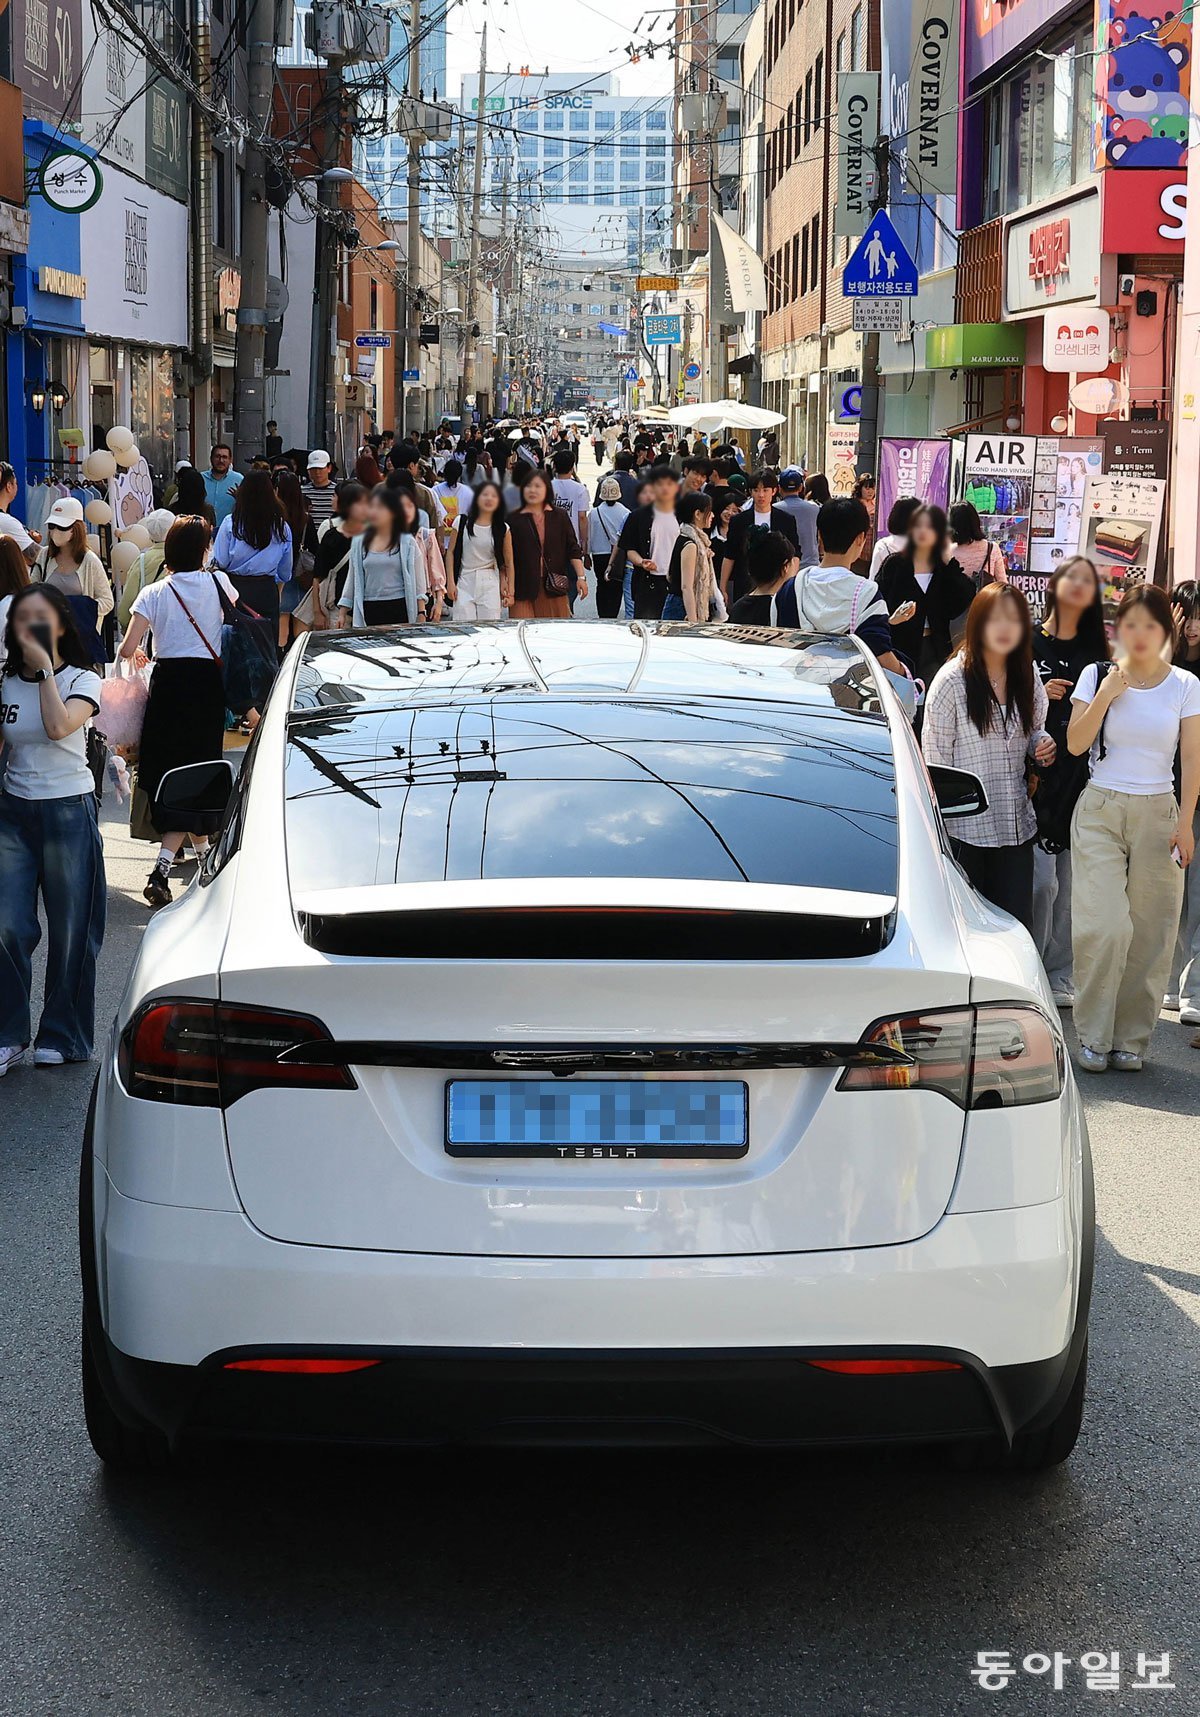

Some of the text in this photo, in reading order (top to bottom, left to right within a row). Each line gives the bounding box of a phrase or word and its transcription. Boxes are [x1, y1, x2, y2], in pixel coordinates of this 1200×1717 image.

[918, 17, 949, 168] COVERNAT
[509, 97, 592, 110] THE SPACE
[847, 94, 869, 214] COVERNAT
[738, 246, 752, 296] KINFOLK
[847, 281, 913, 294] 보행자전용도로
[1054, 343, 1101, 356] 인생네컷
[975, 440, 1025, 465] AIR
[1132, 446, 1153, 454] Term
[557, 1148, 637, 1157] TESLA
